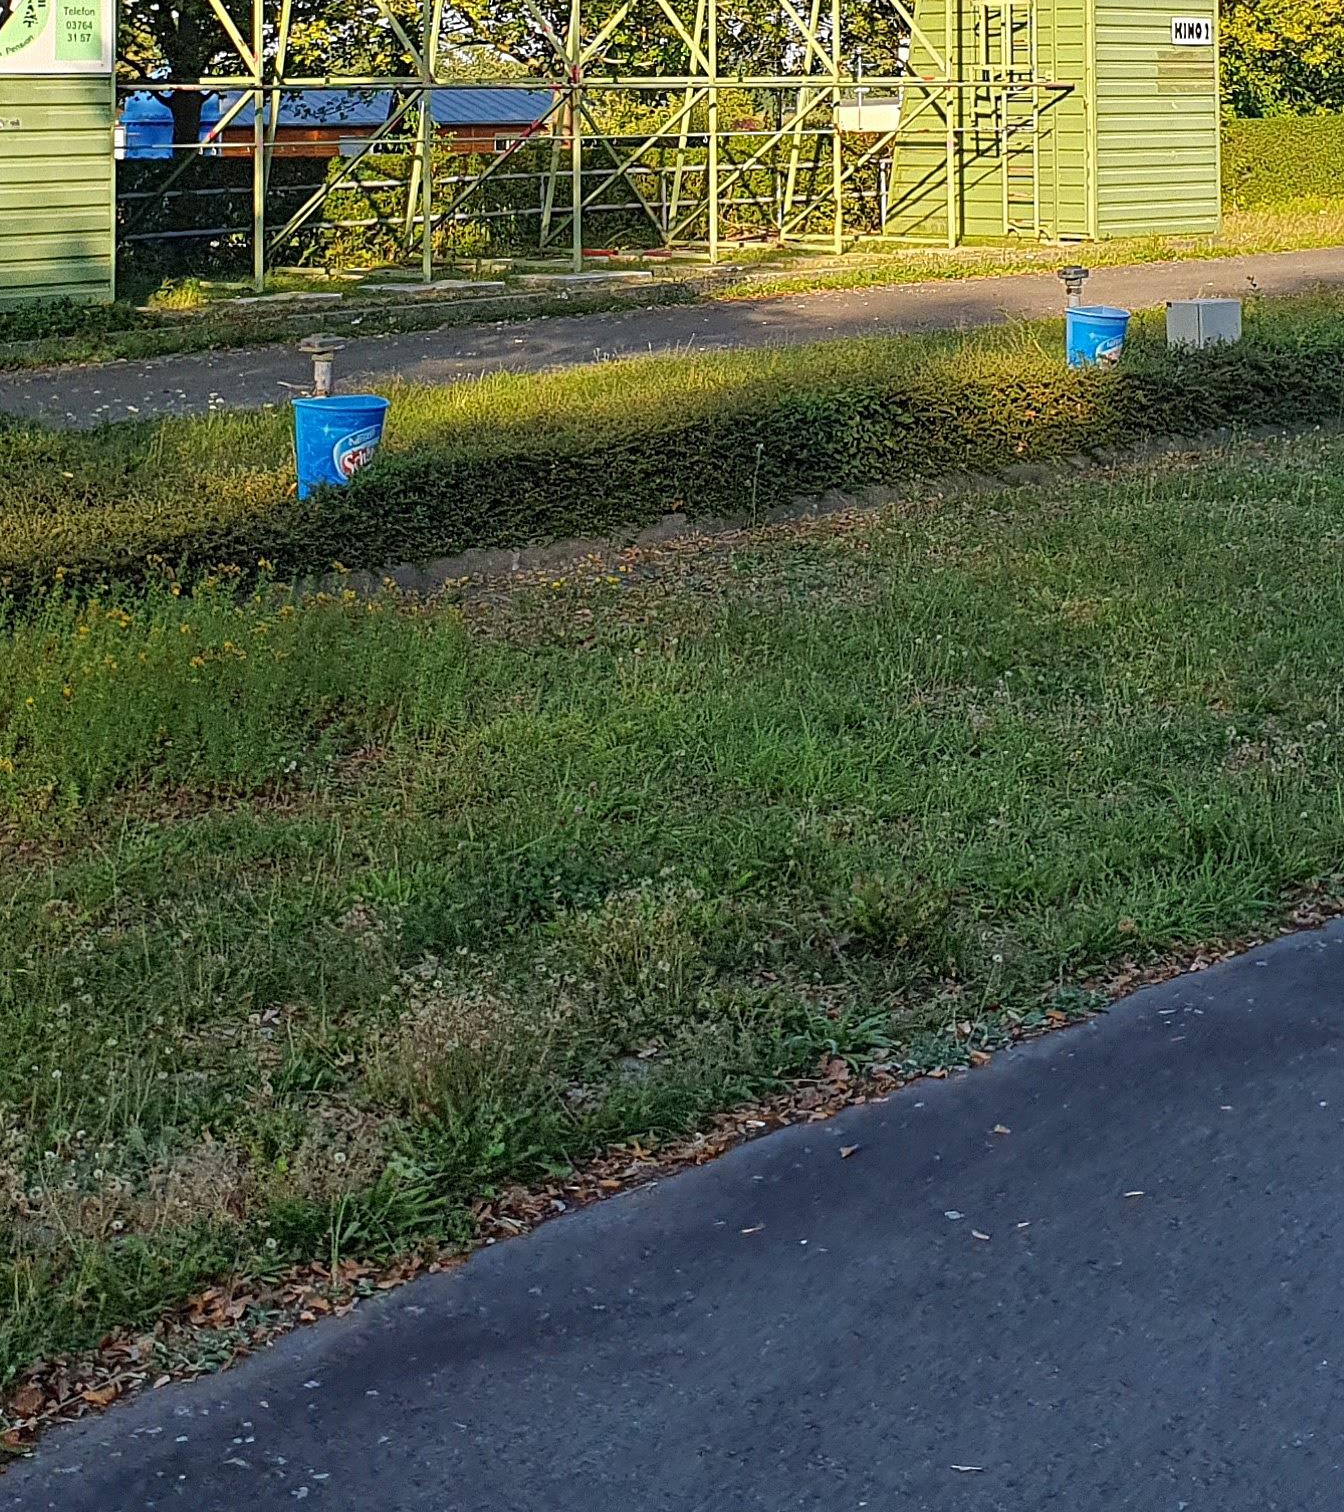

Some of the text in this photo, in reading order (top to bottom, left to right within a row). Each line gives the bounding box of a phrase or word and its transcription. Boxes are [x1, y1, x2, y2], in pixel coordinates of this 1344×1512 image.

[63, 6, 96, 16] Telefon
[66, 20, 93, 30] 03764
[1174, 22, 1202, 39] KINO
